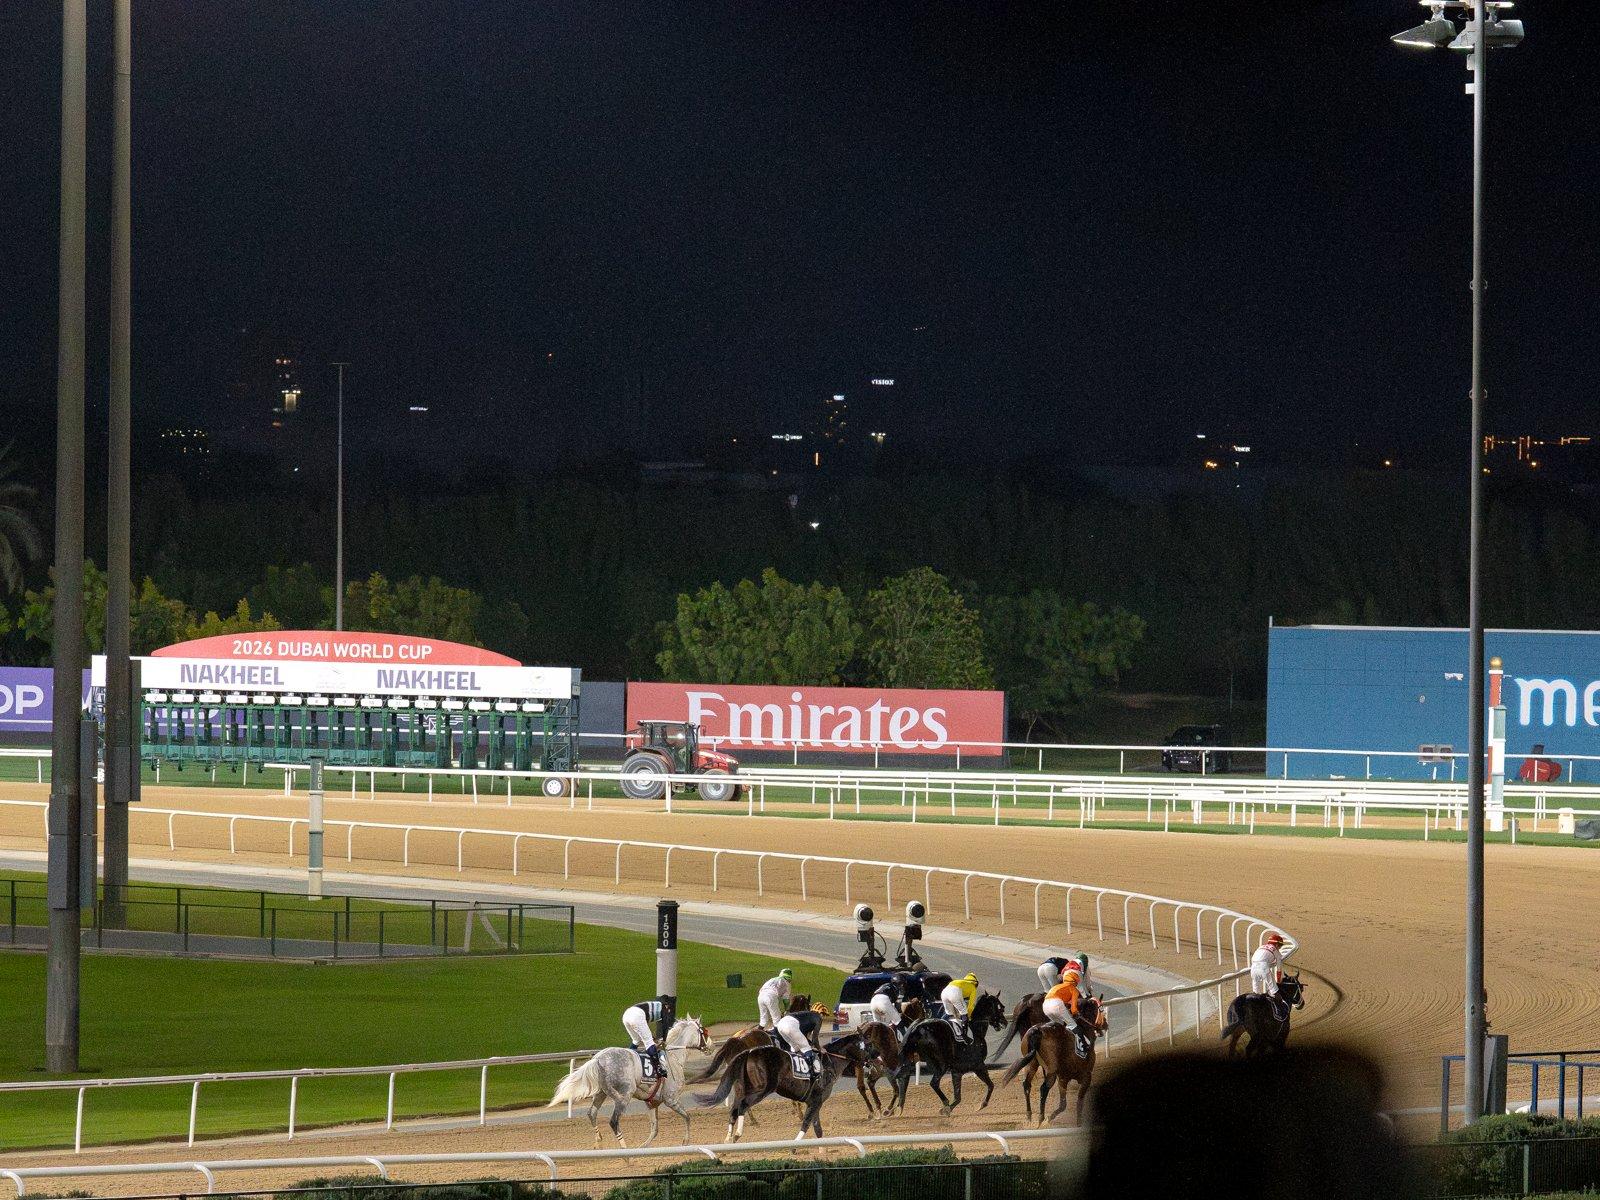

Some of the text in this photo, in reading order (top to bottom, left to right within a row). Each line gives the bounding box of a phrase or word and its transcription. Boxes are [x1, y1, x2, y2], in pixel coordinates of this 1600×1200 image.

[233, 640, 433, 659] 2026 DUBAI WORLD CUP
[181, 664, 284, 686] NAKHEEL
[377, 669, 481, 690] NAKHEEL
[684, 692, 948, 749] Emirates
[662, 913, 670, 947] 1500
[644, 1057, 654, 1077] 5
